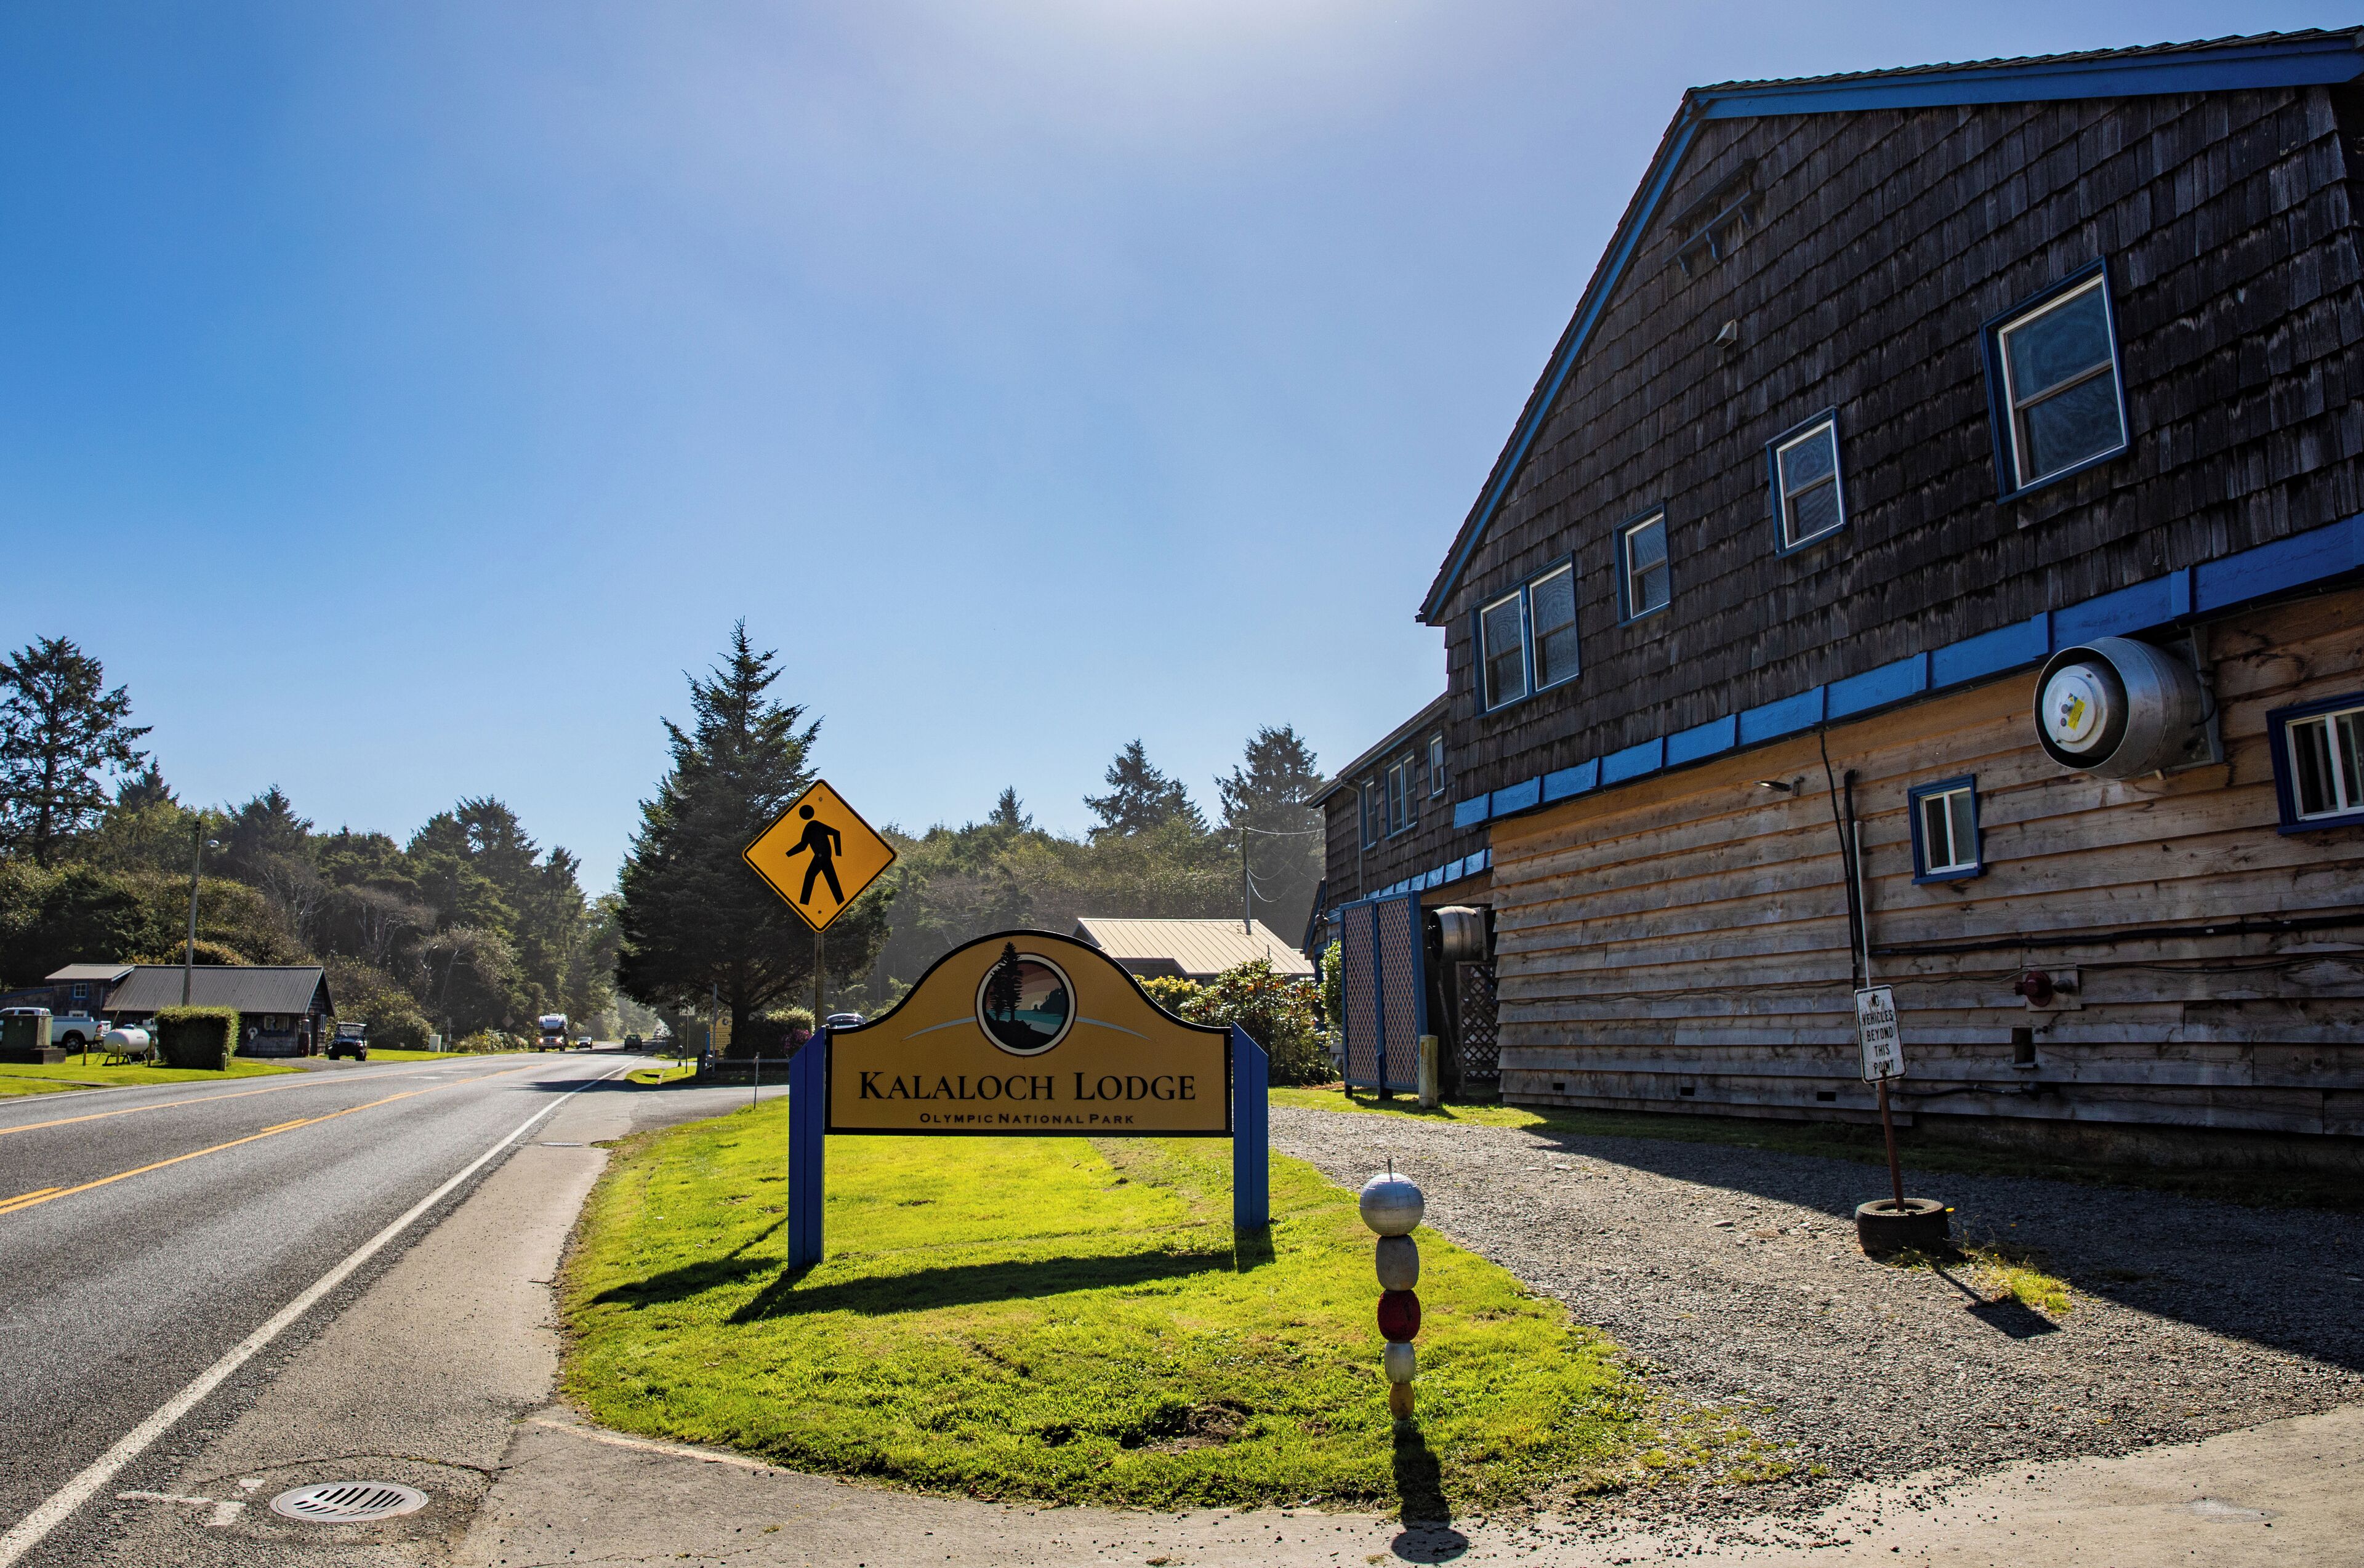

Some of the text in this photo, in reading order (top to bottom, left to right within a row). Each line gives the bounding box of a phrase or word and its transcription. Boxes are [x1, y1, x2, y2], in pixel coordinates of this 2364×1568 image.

[1871, 994, 1880, 1007] NO
[1862, 1010, 1894, 1026] VEHICLES
[1867, 1026, 1894, 1042] BEYOND
[1875, 1044, 1890, 1057] THIS
[1873, 1059, 1894, 1074] POINT
[858, 1072, 1196, 1101] KALALOCH LODGE
[919, 1112, 1135, 1125] OLYMPIC NATIONAL PARK
